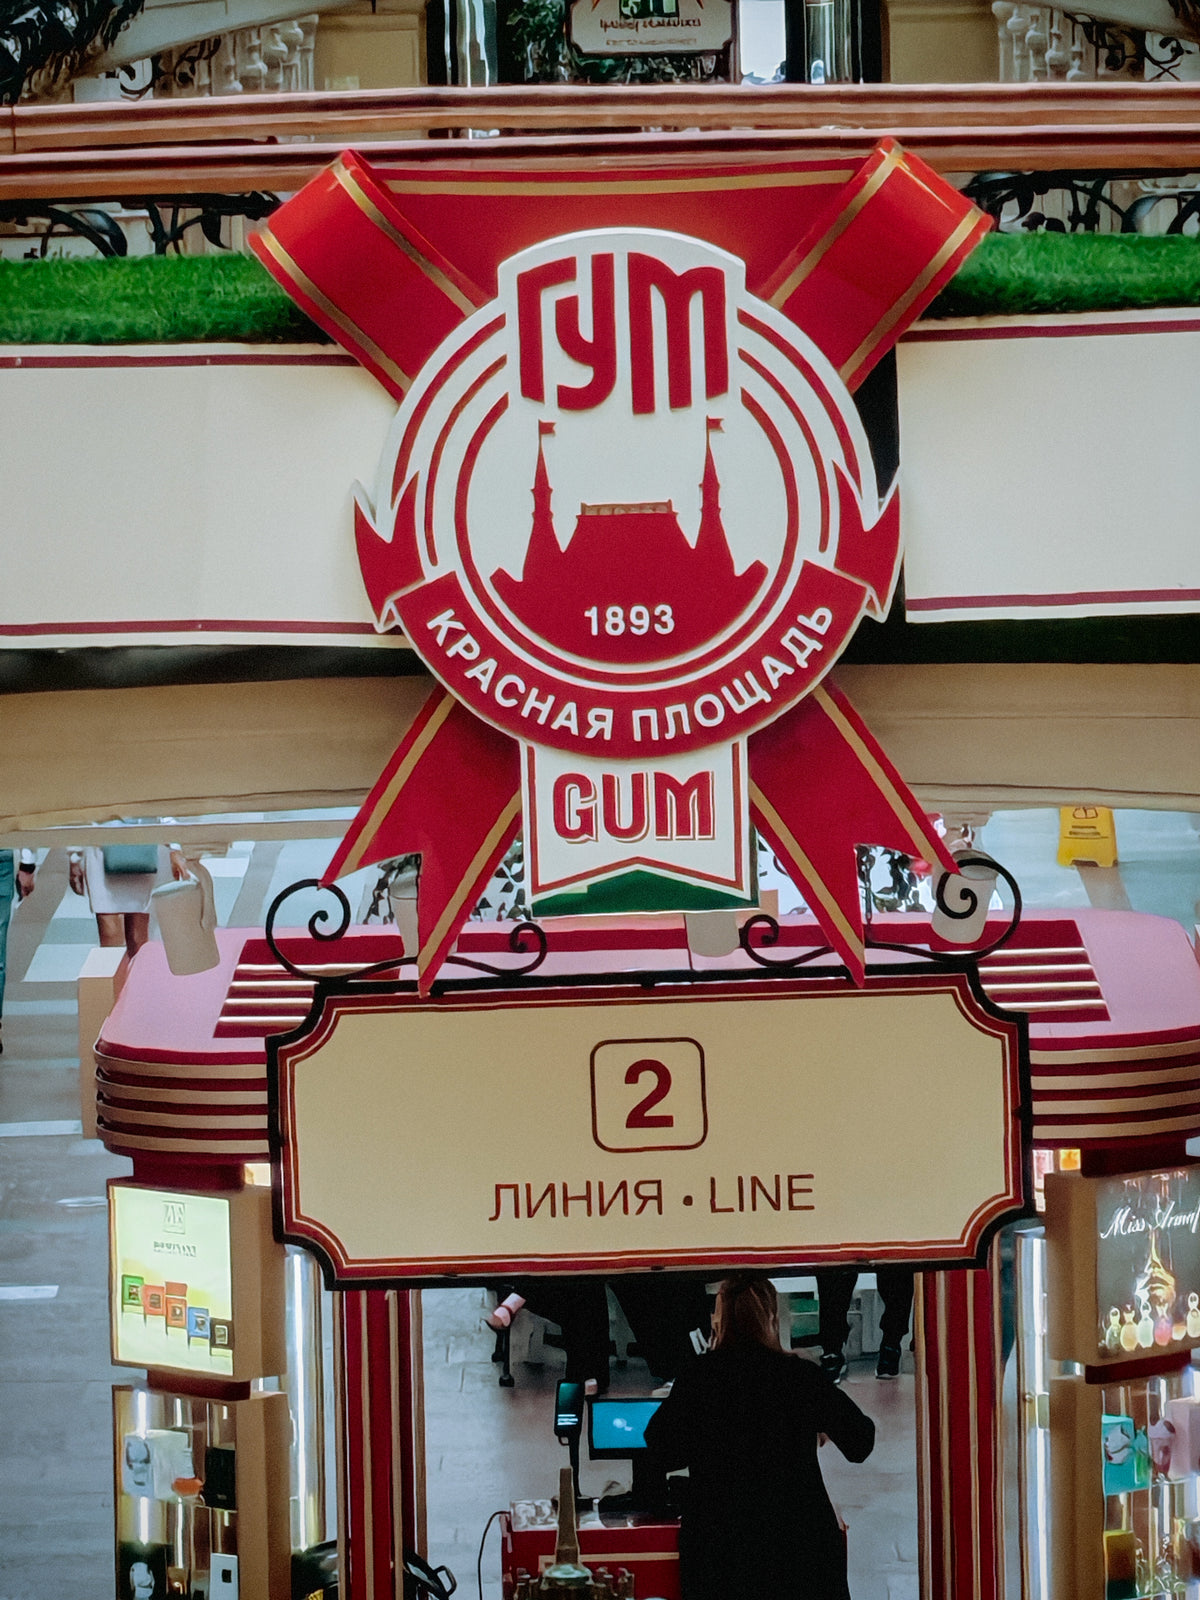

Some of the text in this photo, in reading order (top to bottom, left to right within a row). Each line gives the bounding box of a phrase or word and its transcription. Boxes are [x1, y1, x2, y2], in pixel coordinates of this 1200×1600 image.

[517, 252, 729, 415] ГУМ
[584, 604, 675, 636] 1893
[427, 606, 833, 742] КРАСНАЯ ПЛОЩАДЬ
[552, 770, 715, 844] GUM
[624, 1059, 674, 1129] 2
[488, 1174, 815, 1221] ЛИНИЯ LINE
[1100, 1206, 1146, 1239] Miss
